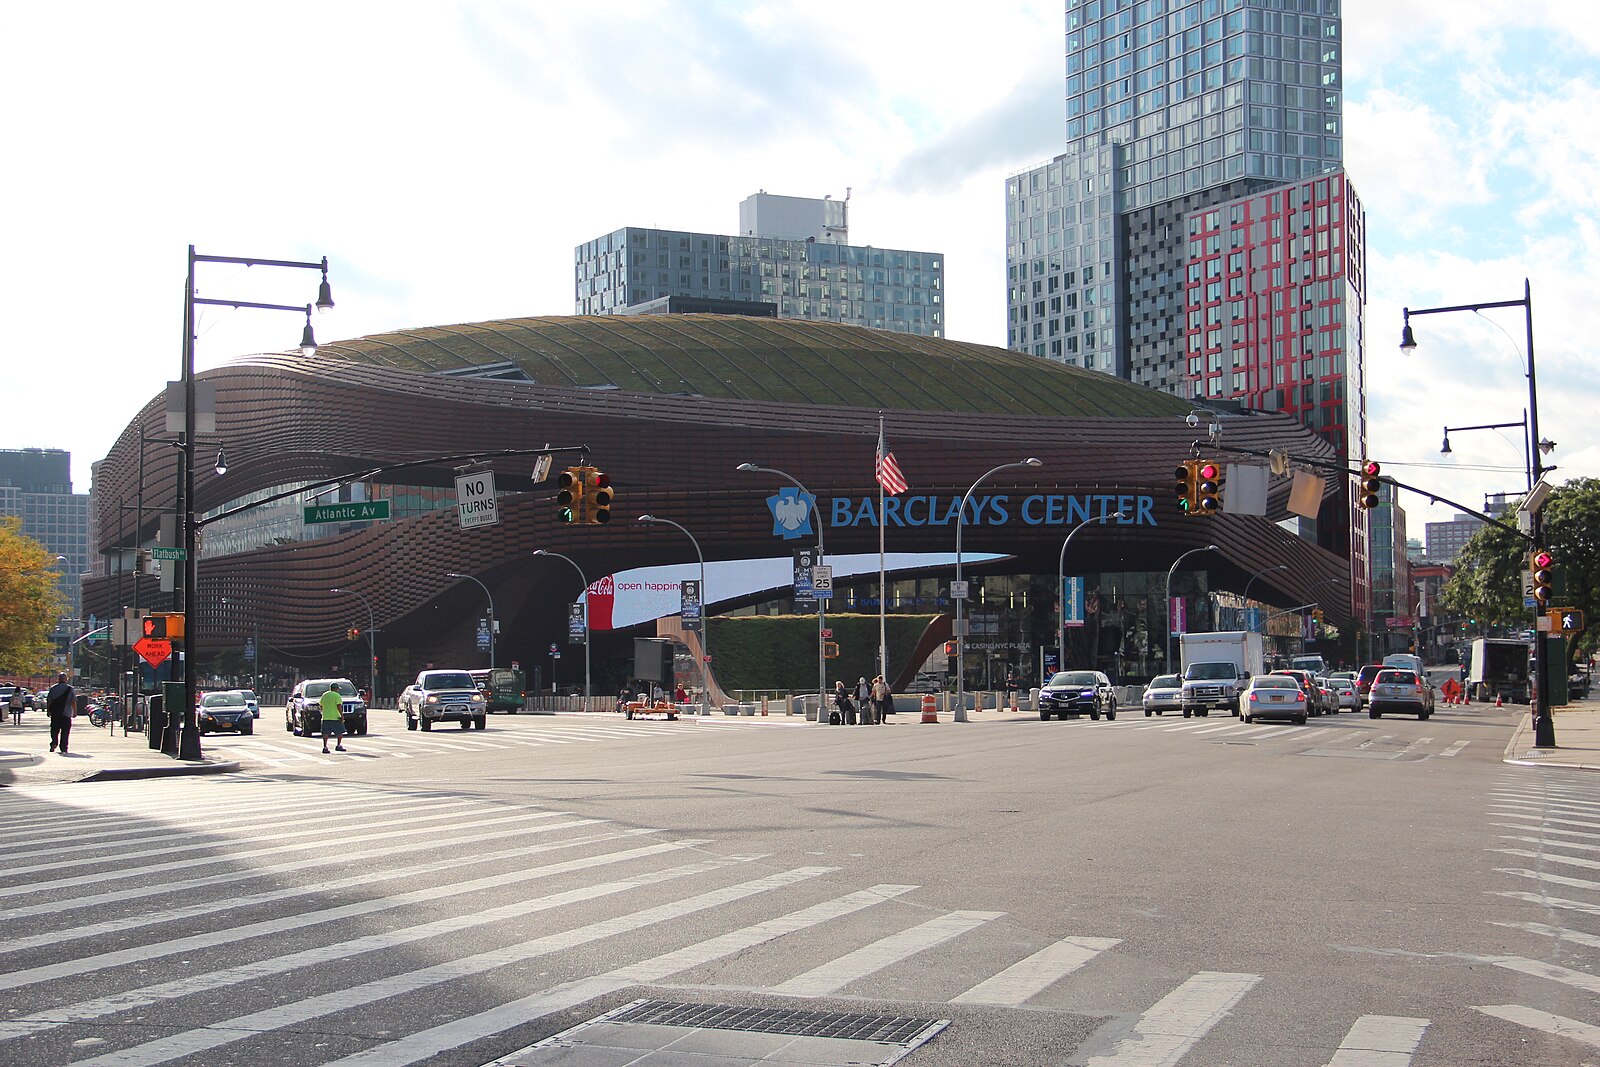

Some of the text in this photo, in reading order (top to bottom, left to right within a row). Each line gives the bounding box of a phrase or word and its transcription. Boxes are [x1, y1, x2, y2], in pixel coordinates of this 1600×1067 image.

[466, 481, 484, 496] NO
[460, 498, 494, 514] TURNS
[830, 495, 1157, 527] BARCLAYS CENTER
[315, 506, 375, 520] Atlantic Av
[153, 549, 179, 559] Flatbush
[618, 582, 642, 591] open
[816, 579, 829, 588] 25
[1526, 586, 1533, 595] 2
